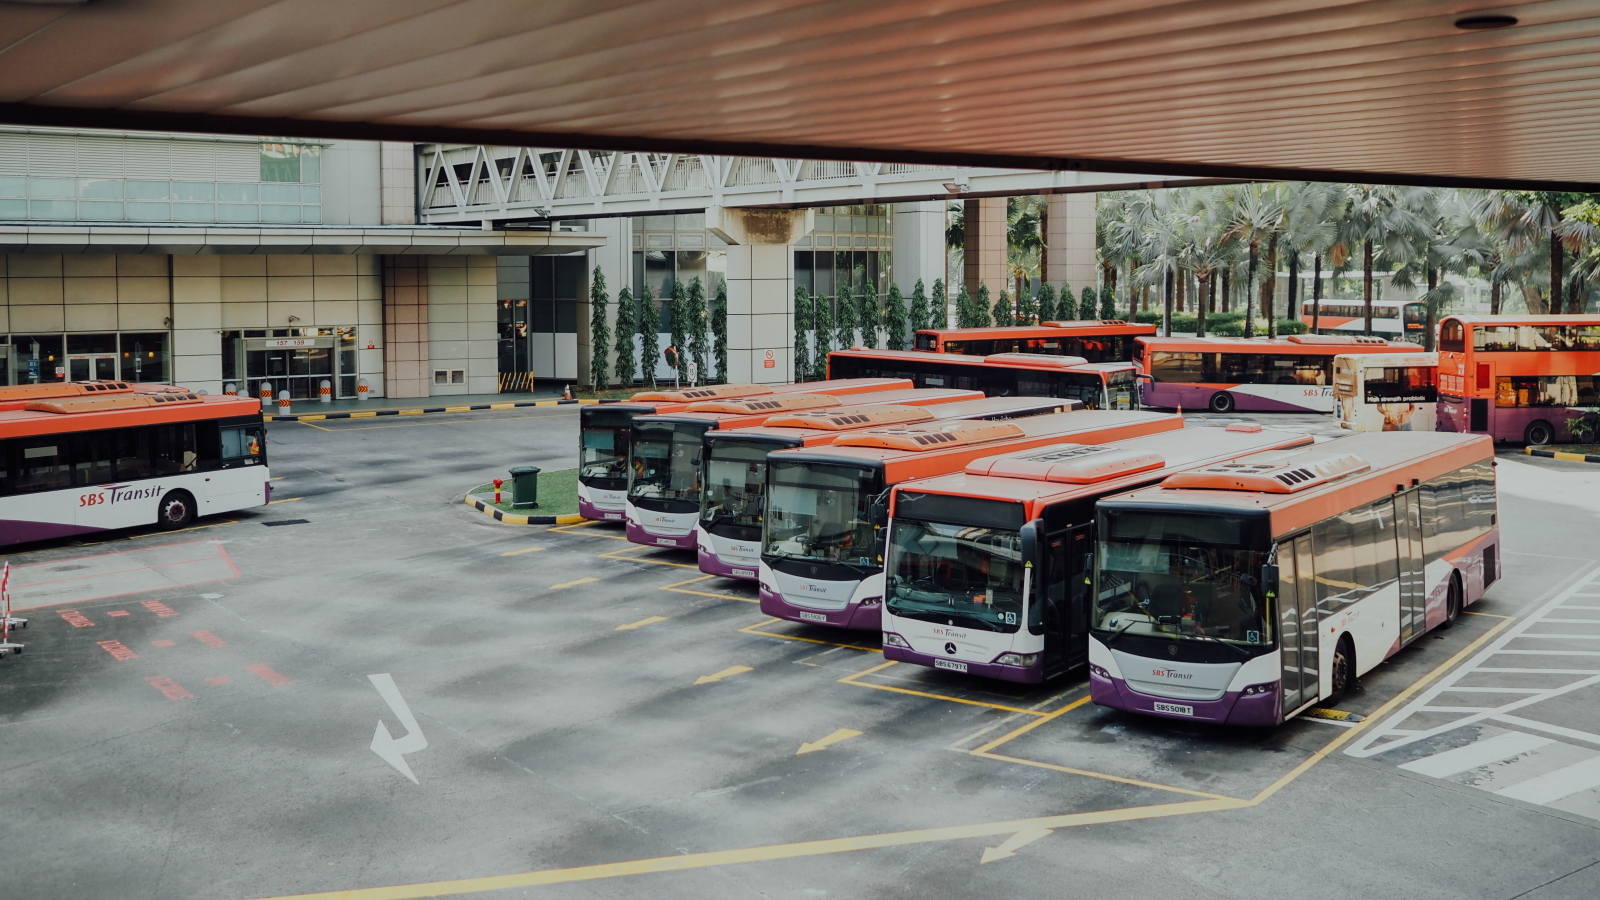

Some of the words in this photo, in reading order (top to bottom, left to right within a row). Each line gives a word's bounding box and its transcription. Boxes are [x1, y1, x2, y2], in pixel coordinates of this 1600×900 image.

[1303, 389, 1318, 397] SBS
[79, 492, 105, 507] SBS
[104, 484, 166, 505] Transit
[807, 584, 827, 593] Transit
[944, 629, 967, 639] Transit
[935, 659, 967, 671] SBS6797X
[1152, 669, 1165, 677] SBS
[1165, 669, 1194, 680] Transit
